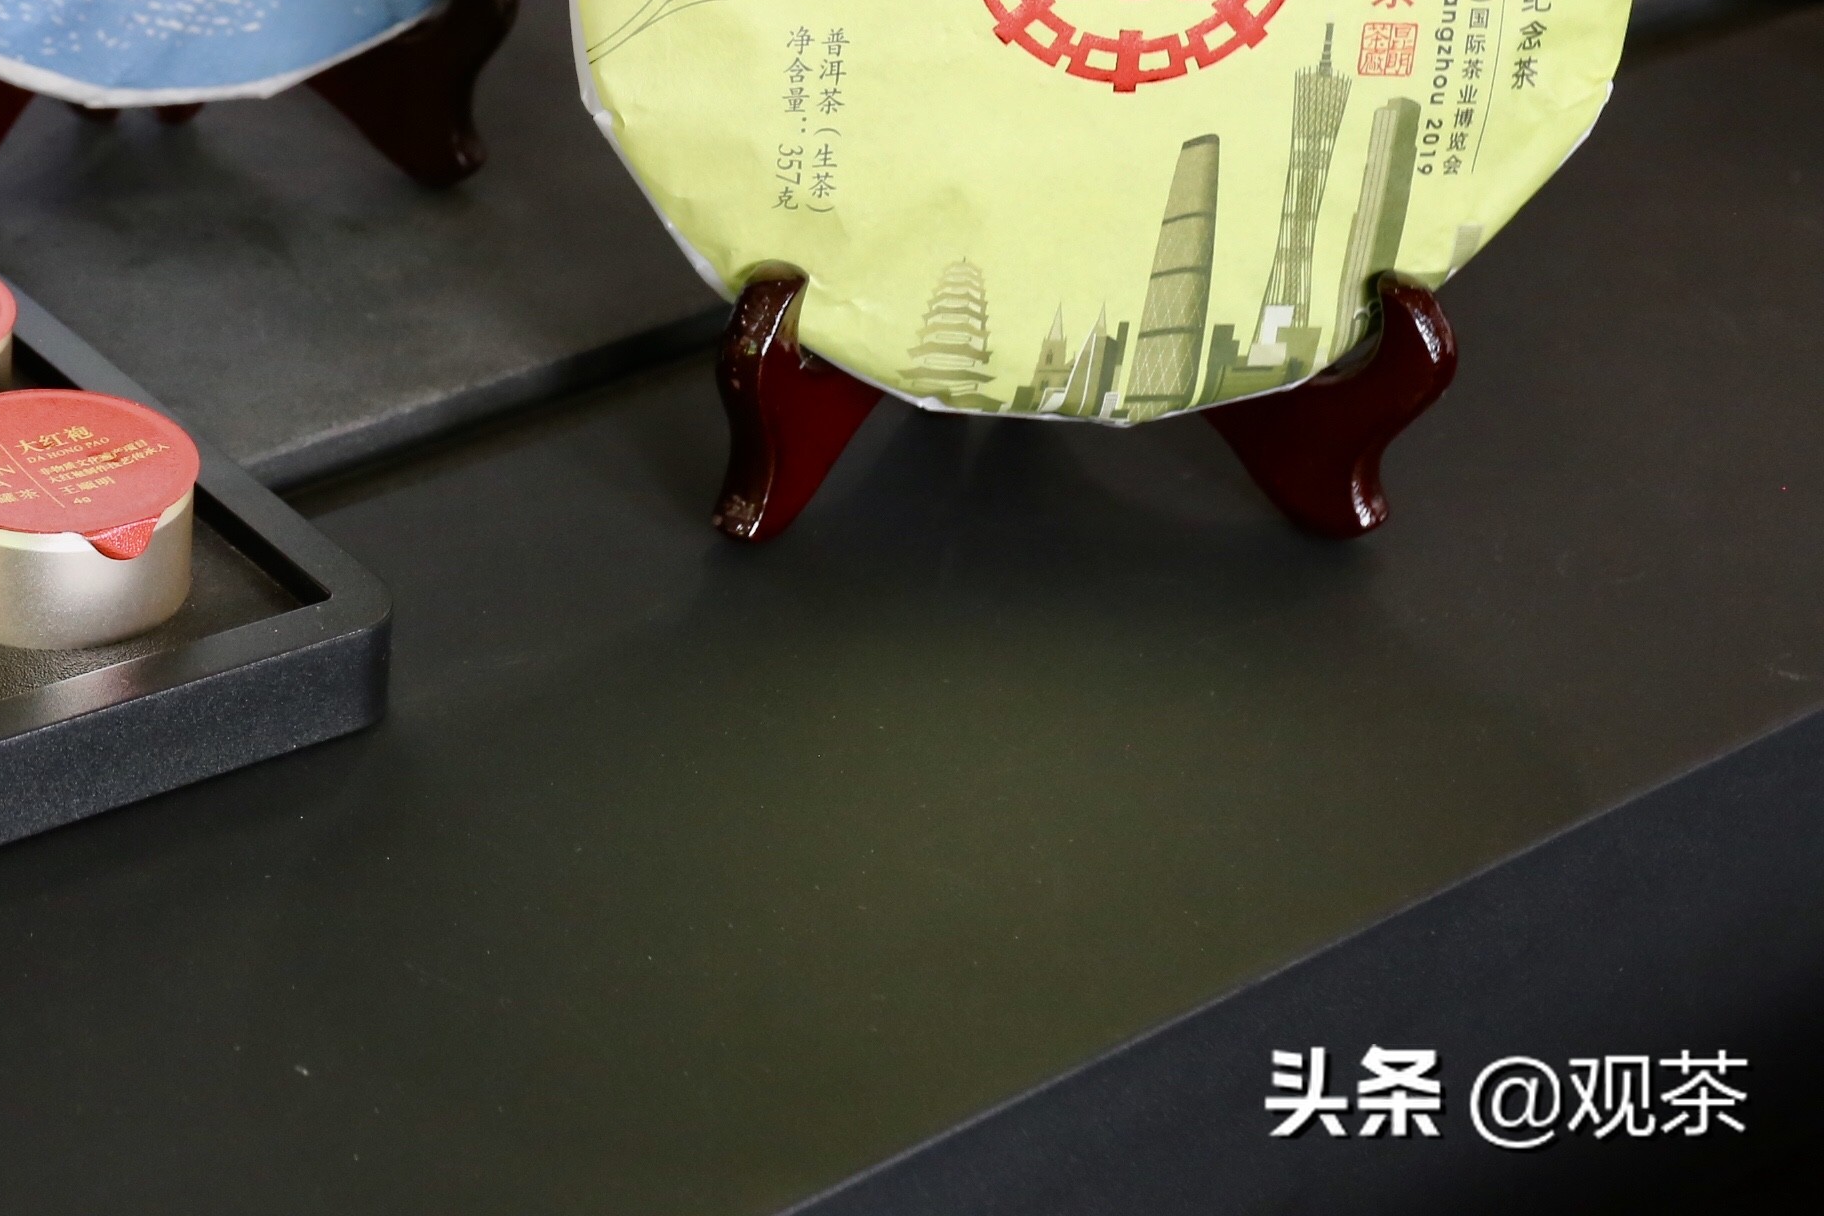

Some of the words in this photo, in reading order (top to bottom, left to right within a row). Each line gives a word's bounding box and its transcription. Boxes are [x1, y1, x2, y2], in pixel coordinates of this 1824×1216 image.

[806, 27, 850, 213] 普洱茶（生茶）
[1417, 119, 1443, 175] 2019
[14, 425, 95, 455] 大红袍
[26, 452, 46, 464] DA
[46, 443, 84, 460] HONG
[85, 436, 110, 449] PAO
[61, 476, 116, 495] 王顺明
